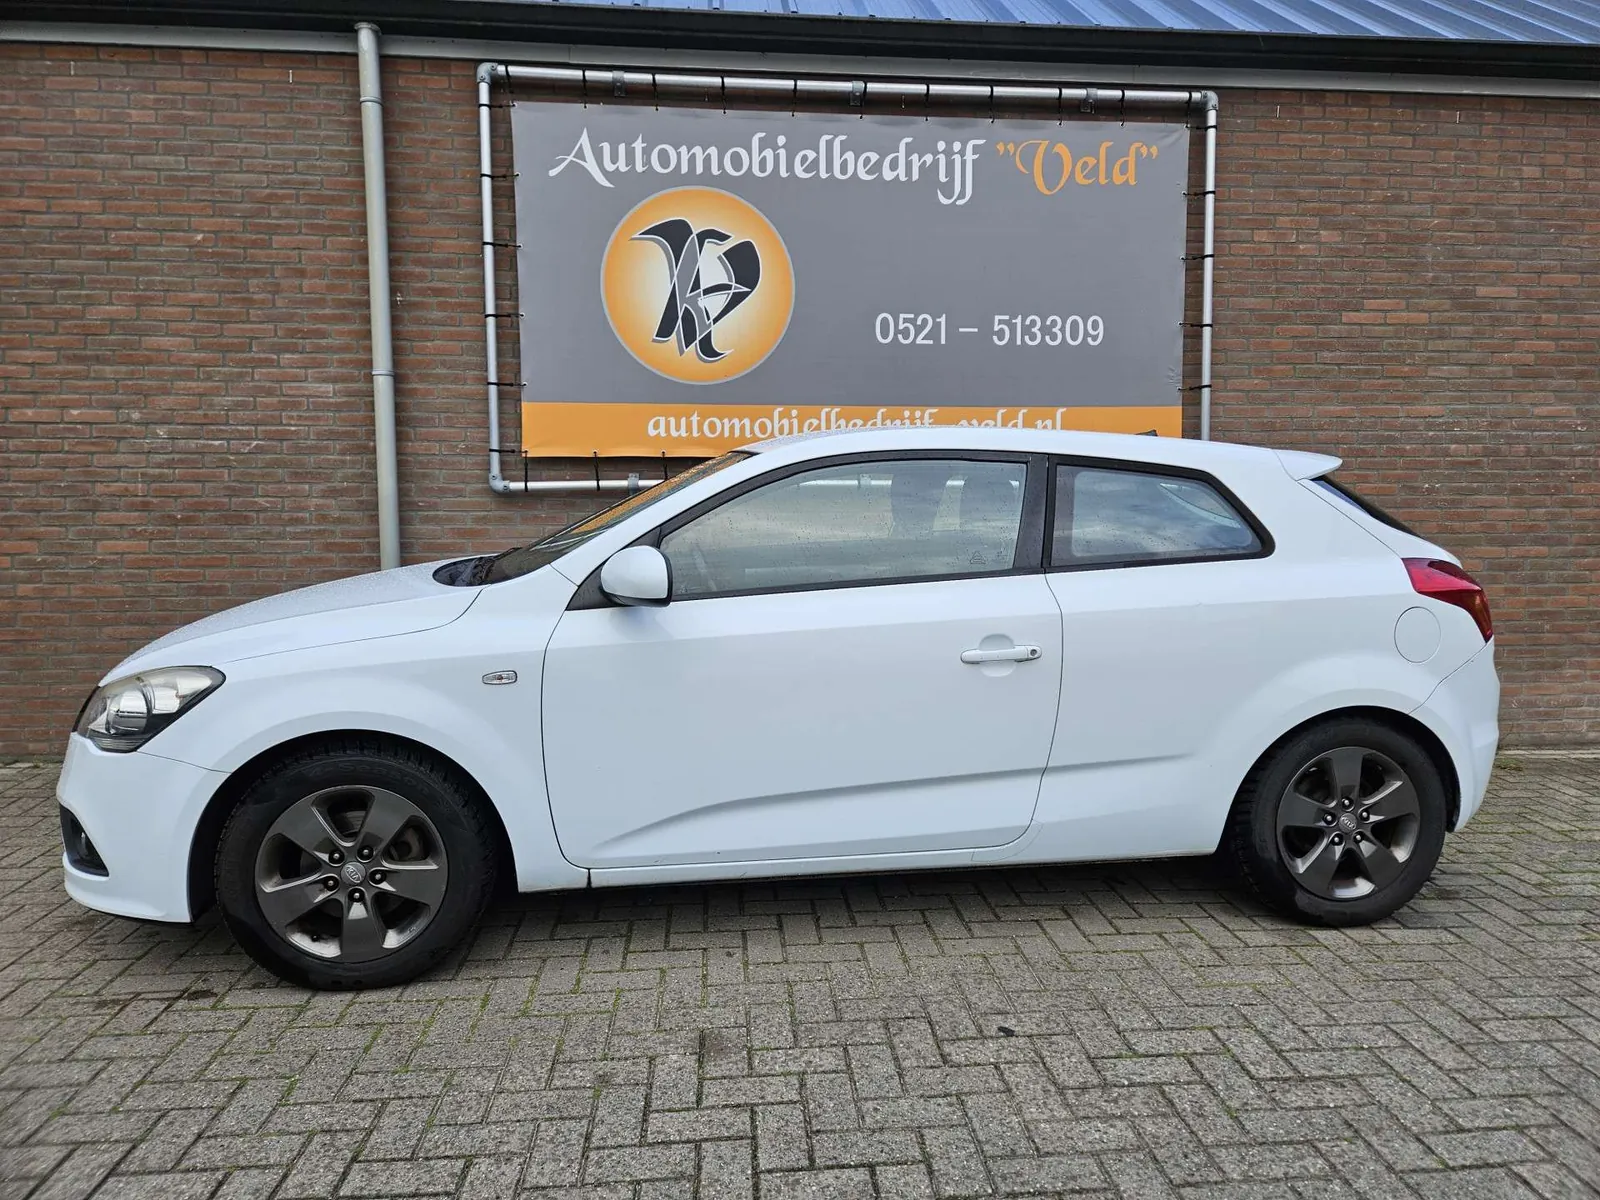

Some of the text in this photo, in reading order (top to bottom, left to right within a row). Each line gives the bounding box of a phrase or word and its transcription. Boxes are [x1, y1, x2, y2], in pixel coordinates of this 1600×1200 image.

[548, 127, 987, 205] Automobielbedrijf
[875, 312, 947, 345] 0521
[992, 314, 1105, 346] 513309
[647, 408, 1067, 438] automobielbedrifldnl
